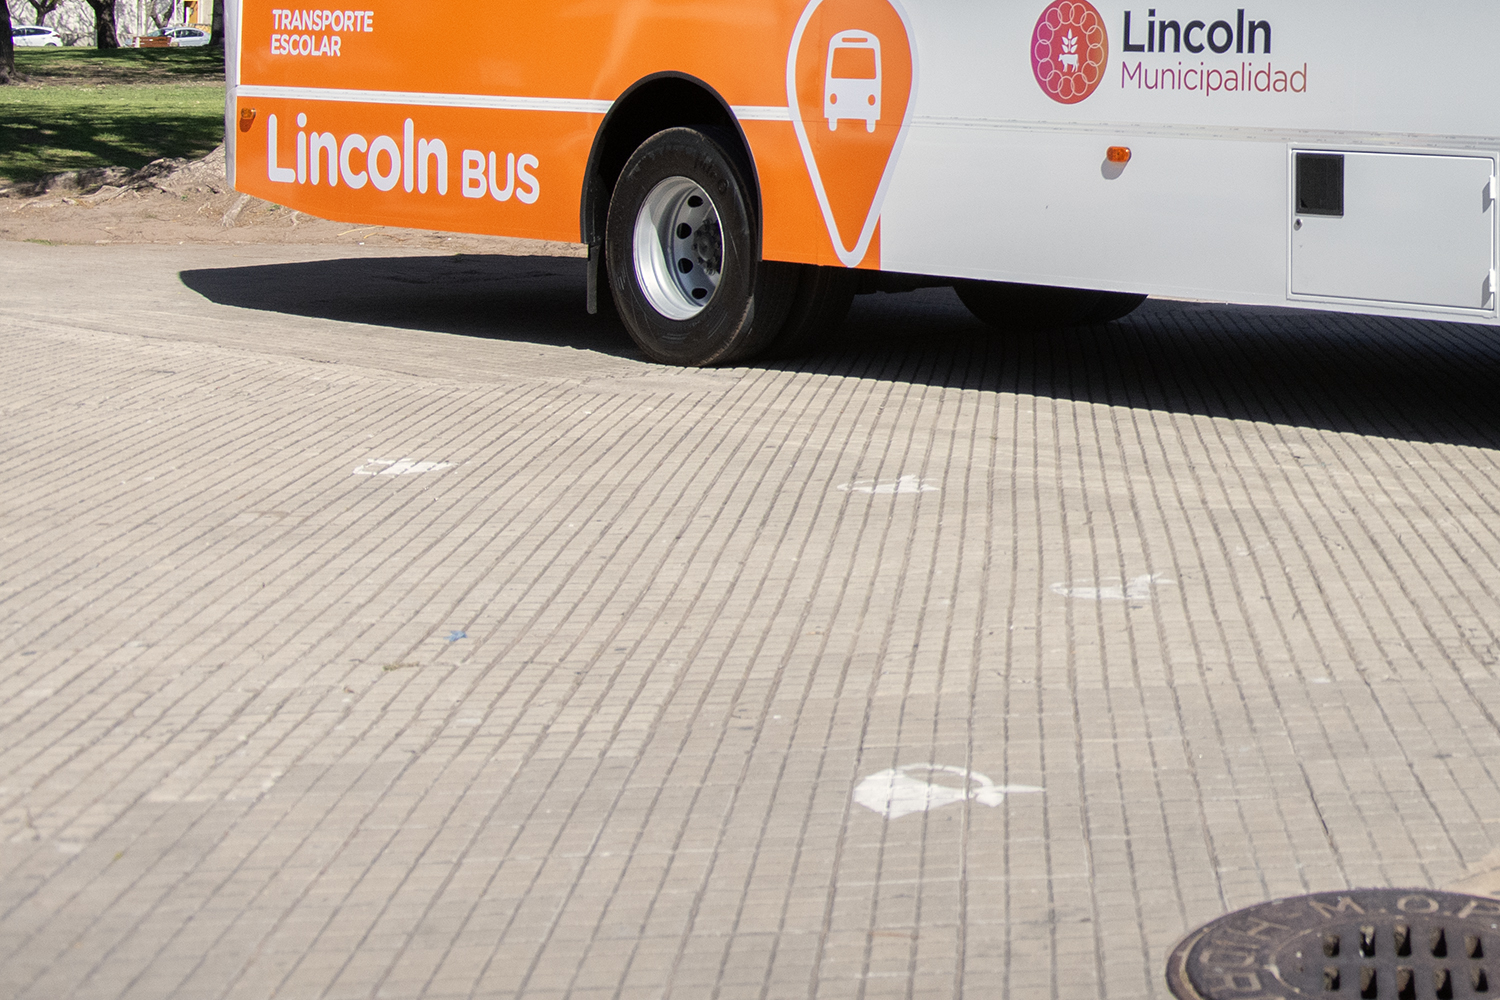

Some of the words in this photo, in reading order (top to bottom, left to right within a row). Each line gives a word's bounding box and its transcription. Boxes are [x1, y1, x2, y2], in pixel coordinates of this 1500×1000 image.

[272, 9, 374, 32] TRANSPORTE
[1122, 8, 1271, 54] Lincoln
[271, 34, 341, 56] ESCOLAR
[1121, 61, 1307, 97] Municipalidad
[268, 112, 448, 196] Lincoln
[462, 149, 540, 205] BUS
